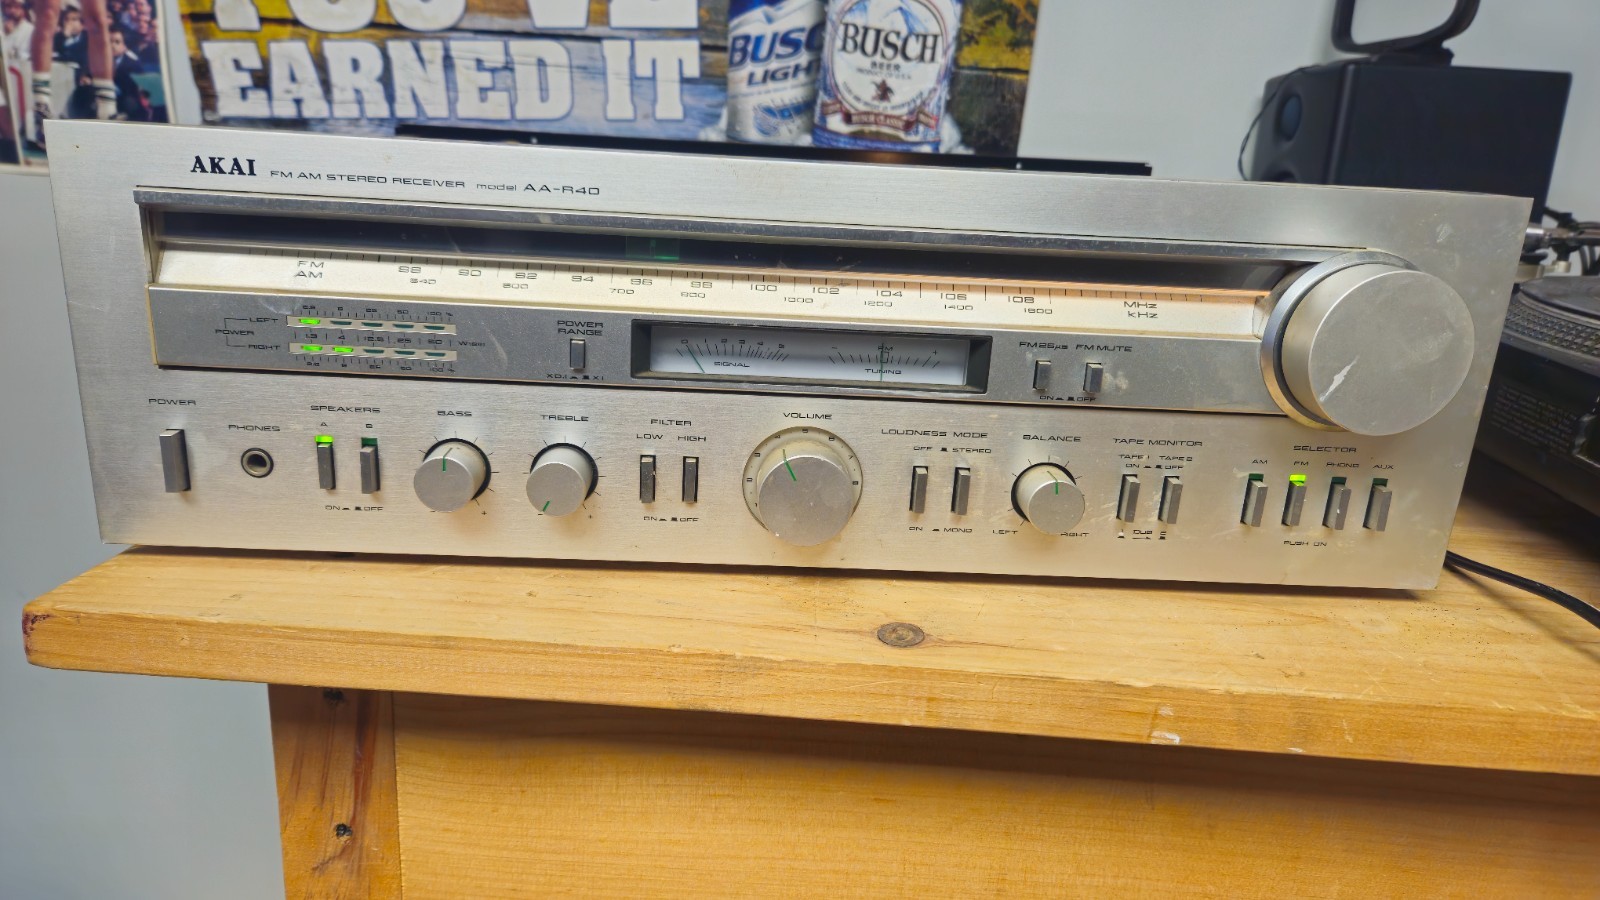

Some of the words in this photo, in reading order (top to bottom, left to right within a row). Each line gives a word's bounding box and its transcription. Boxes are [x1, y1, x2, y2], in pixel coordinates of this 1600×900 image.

[838, 22, 942, 64] BUSCH
[201, 39, 574, 121] EARNED
[601, 39, 701, 121] IT
[190, 155, 257, 176] AKAI
[270, 170, 293, 179] FM
[297, 172, 321, 180] AM
[326, 173, 387, 184] STEREO
[392, 177, 465, 188] RECEIVER
[476, 183, 517, 191] model
[523, 184, 600, 196] AA-R40
[297, 260, 324, 269] FM
[399, 265, 422, 274] 88
[458, 268, 482, 277] 90
[515, 272, 538, 280] 92
[571, 275, 594, 283] 94
[630, 278, 653, 286] 96
[690, 281, 713, 289] 98
[750, 283, 778, 292] 100
[812, 287, 840, 295] 102
[876, 290, 903, 298] 104
[940, 292, 967, 301] 106
[1007, 295, 1035, 304] 108
[1123, 301, 1158, 309] MHz
[294, 270, 323, 279] AM
[609, 287, 635, 295] 700
[1127, 310, 1159, 319] kHz
[557, 320, 604, 328] POWER
[557, 328, 603, 336] RANGE
[148, 398, 197, 406] POWER
[310, 404, 381, 413] SPEAKERS
[540, 414, 589, 422] TREBLE
[783, 412, 833, 420] VOLUME
[650, 418, 692, 427] FILTER
[228, 424, 281, 432] PHONES
[881, 428, 947, 437] LOUDNESS
[952, 431, 989, 439] MODE
[1022, 434, 1082, 443] BALANCE
[1112, 437, 1145, 445] TAPE
[1148, 439, 1204, 447] MONITOR
[1293, 445, 1357, 453] SELECTOR
